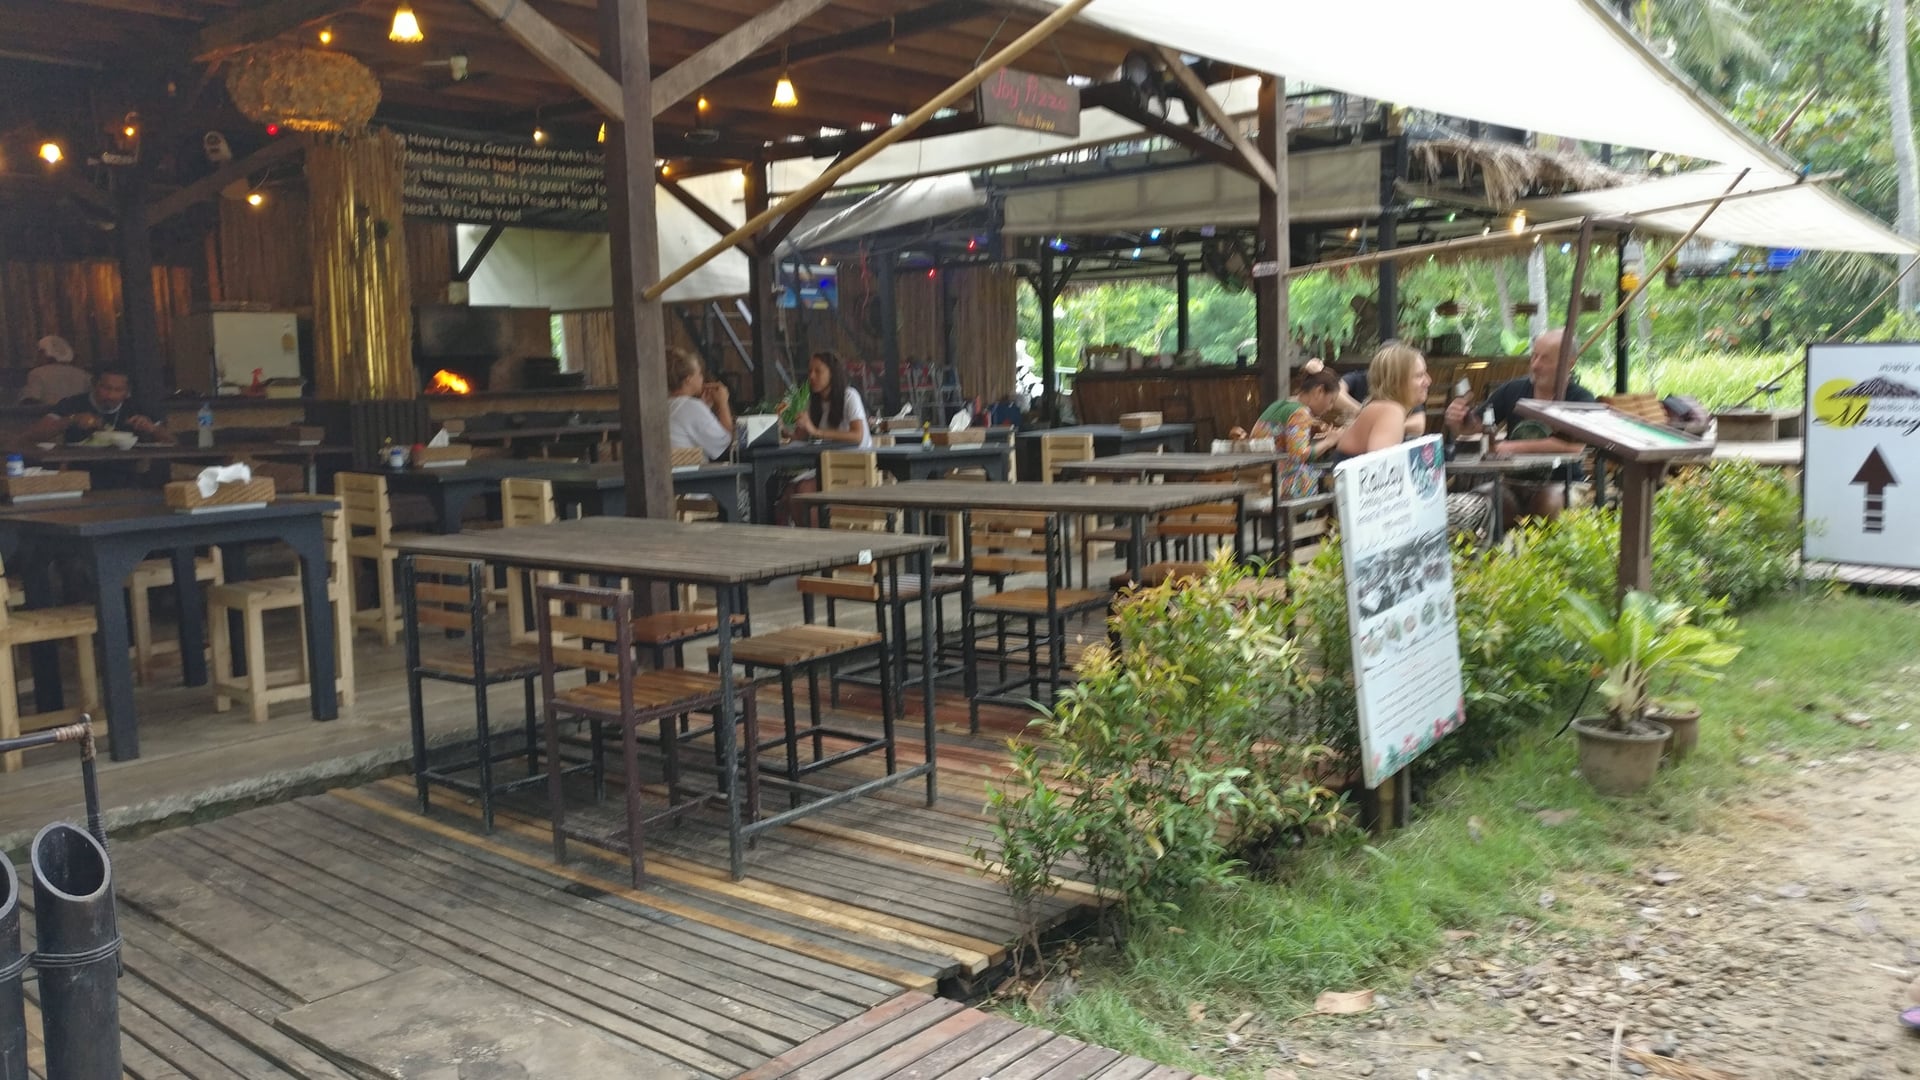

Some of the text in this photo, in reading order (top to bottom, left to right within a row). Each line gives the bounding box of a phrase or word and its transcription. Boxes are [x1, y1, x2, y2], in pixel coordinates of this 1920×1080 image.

[408, 133, 441, 148] Have
[443, 137, 471, 152] Loss
[472, 144, 480, 153] a
[482, 143, 516, 157] Great
[518, 145, 557, 160] Leader
[559, 149, 584, 161] who
[404, 149, 432, 164] rked
[436, 152, 465, 168] hard
[467, 157, 491, 170] and
[493, 158, 516, 172] had
[518, 162, 549, 176] good
[422, 168, 445, 182] the
[447, 171, 491, 187] nation.
[493, 174, 517, 189] This
[519, 177, 528, 190] is
[530, 180, 538, 190] a
[539, 180, 569, 195] great
[571, 181, 594, 195] loss
[595, 182, 608, 196] to
[450, 187, 479, 205] King
[480, 189, 506, 205] Rest
[561, 196, 578, 209] He
[580, 197, 598, 211] will
[440, 204, 461, 218] We
[463, 205, 493, 220] Love
[494, 207, 521, 222] You!
